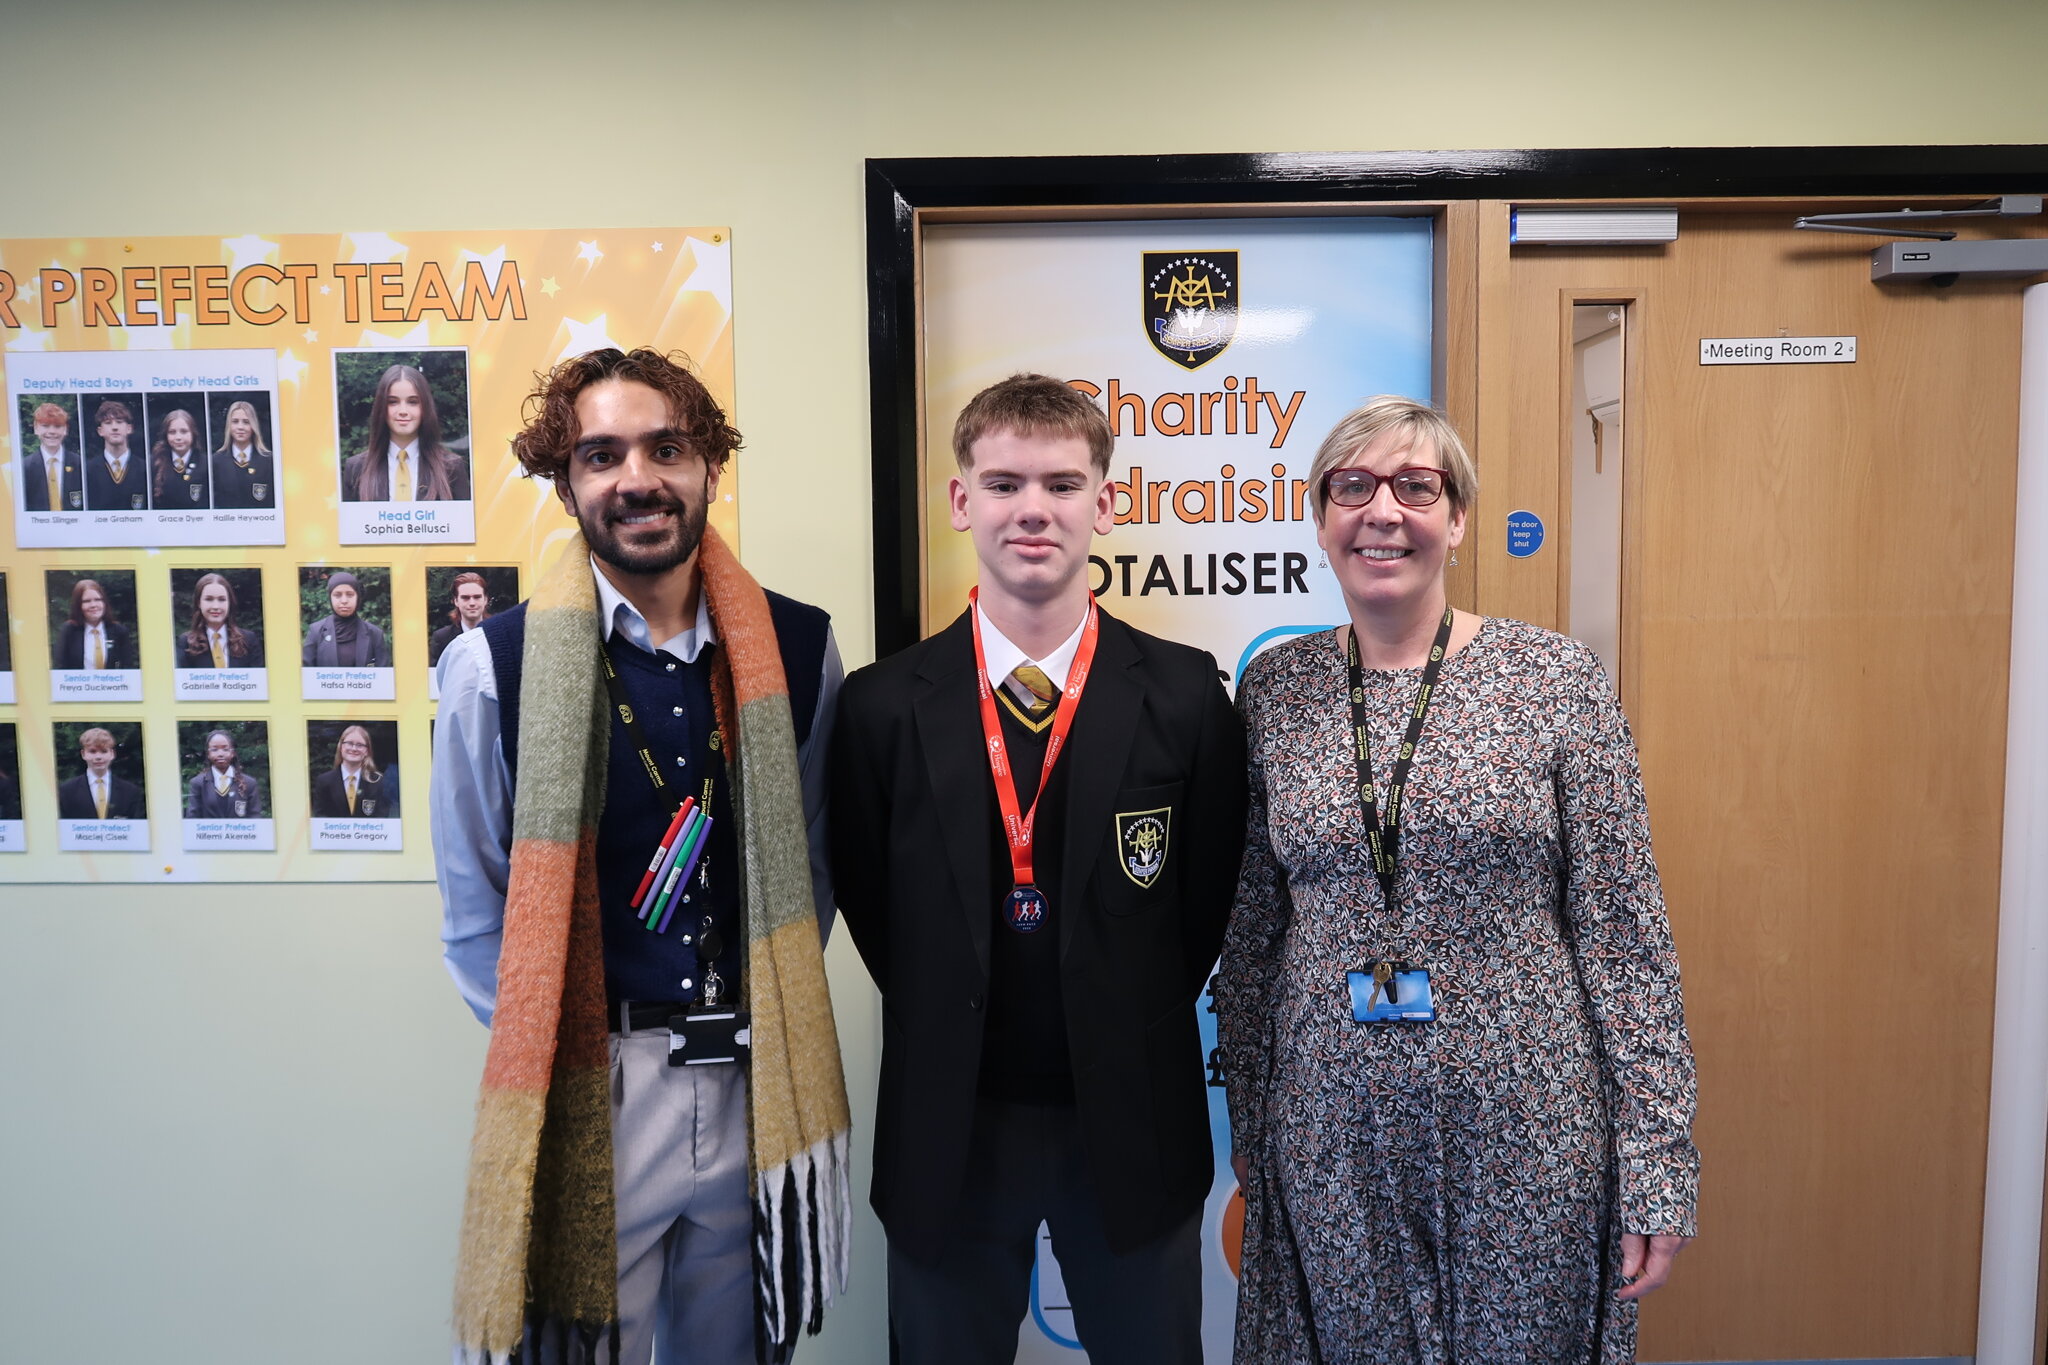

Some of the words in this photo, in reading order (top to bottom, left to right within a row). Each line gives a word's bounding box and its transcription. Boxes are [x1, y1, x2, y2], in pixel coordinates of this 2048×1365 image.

[39, 263, 318, 329] PREFECT
[333, 260, 528, 324] TEAM
[1710, 343, 1773, 360] Meeting
[1780, 342, 1827, 356] Room
[1834, 342, 1844, 356] 2
[23, 378, 66, 390] Deputy
[70, 378, 101, 388] Head
[105, 377, 133, 390] Boys
[151, 376, 194, 388] Deputy
[198, 376, 230, 386] Head
[234, 376, 259, 386] Girls
[1113, 463, 1310, 526] draisi
[110, 515, 143, 523] Graham
[378, 510, 410, 520] Head
[414, 510, 435, 520] Girl
[364, 524, 404, 536] Sophia
[407, 523, 450, 534] Bellusci
[1088, 552, 1310, 598] OTALISER
[64, 674, 91, 682] Senior
[93, 674, 124, 682] Prefect
[642, 748, 654, 766] Mount
[651, 765, 665, 787] Carmel
[1393, 784, 1401, 803] Mount
[354, 832, 388, 841] Gregory
[1369, 831, 1378, 854] Carmel
